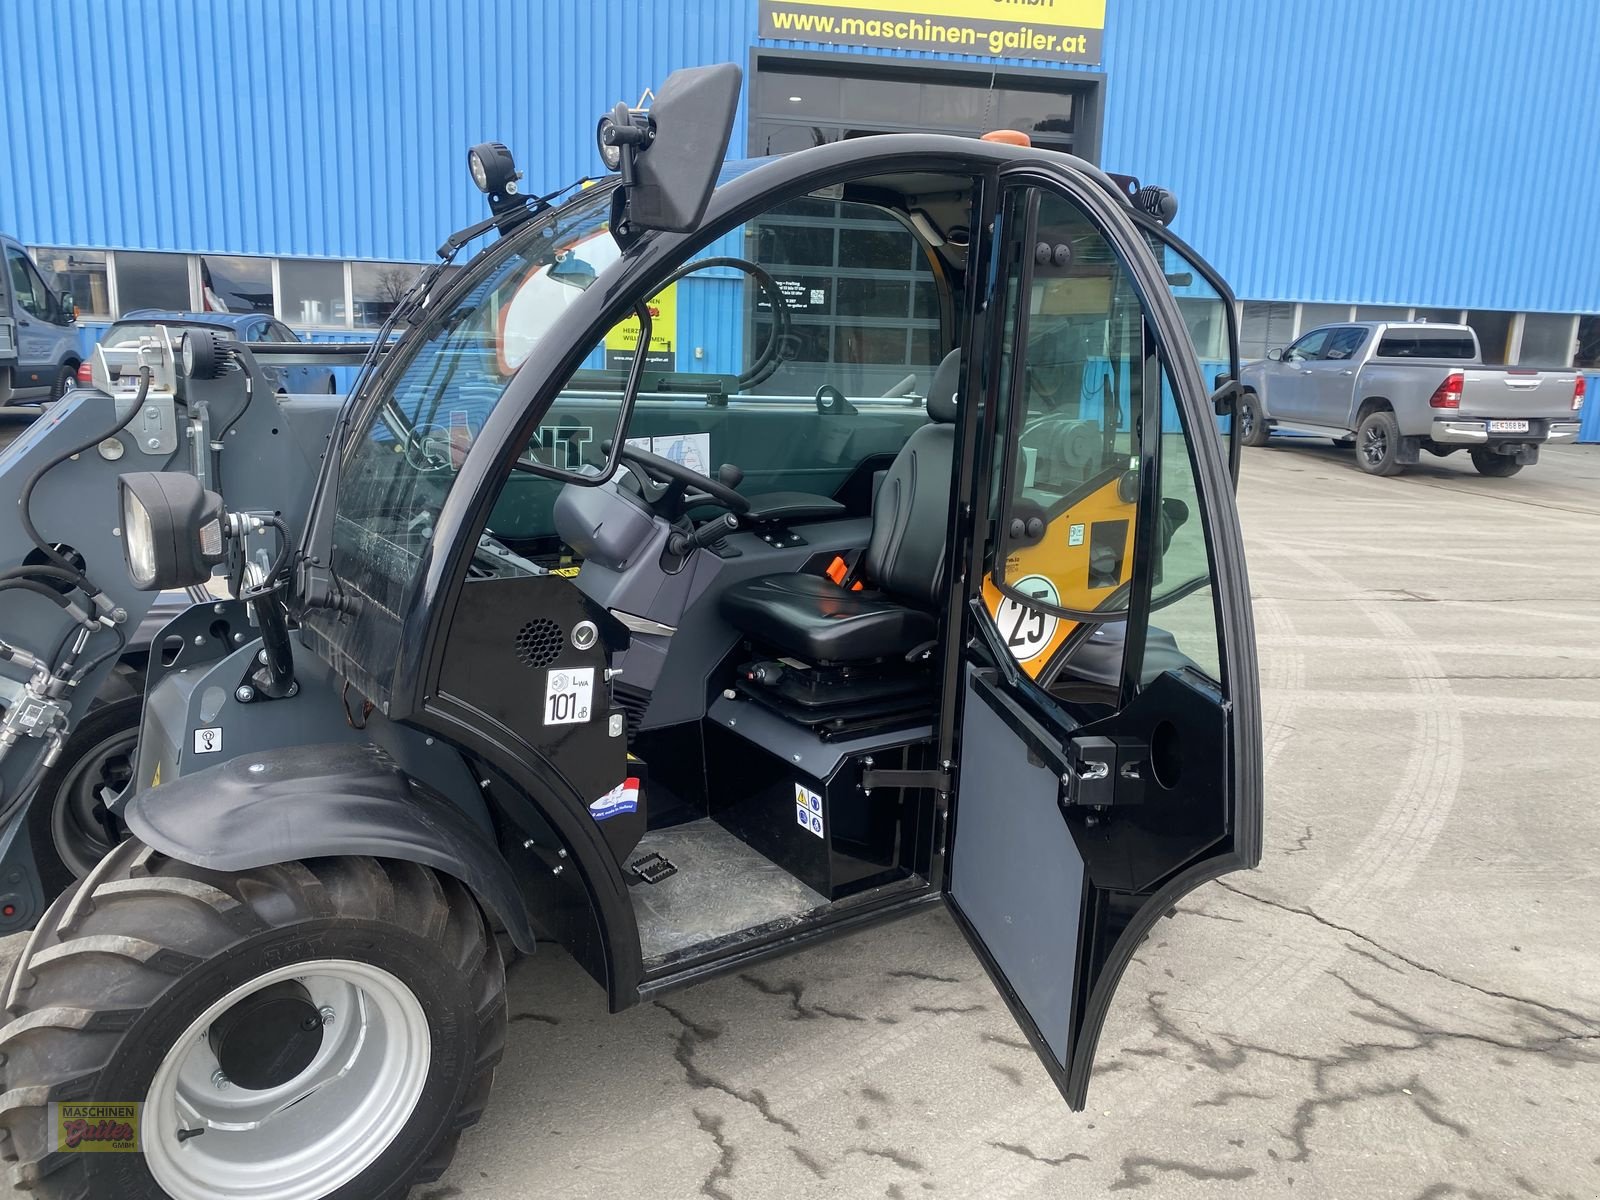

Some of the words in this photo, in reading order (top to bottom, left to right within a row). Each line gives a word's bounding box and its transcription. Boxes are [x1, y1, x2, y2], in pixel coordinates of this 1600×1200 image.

[772, 10, 1087, 54] www.maschinen-gailer.at
[623, 335, 665, 343] WILLMEN
[1008, 590, 1049, 647] 25
[549, 692, 577, 721] 101
[578, 706, 588, 719] dB
